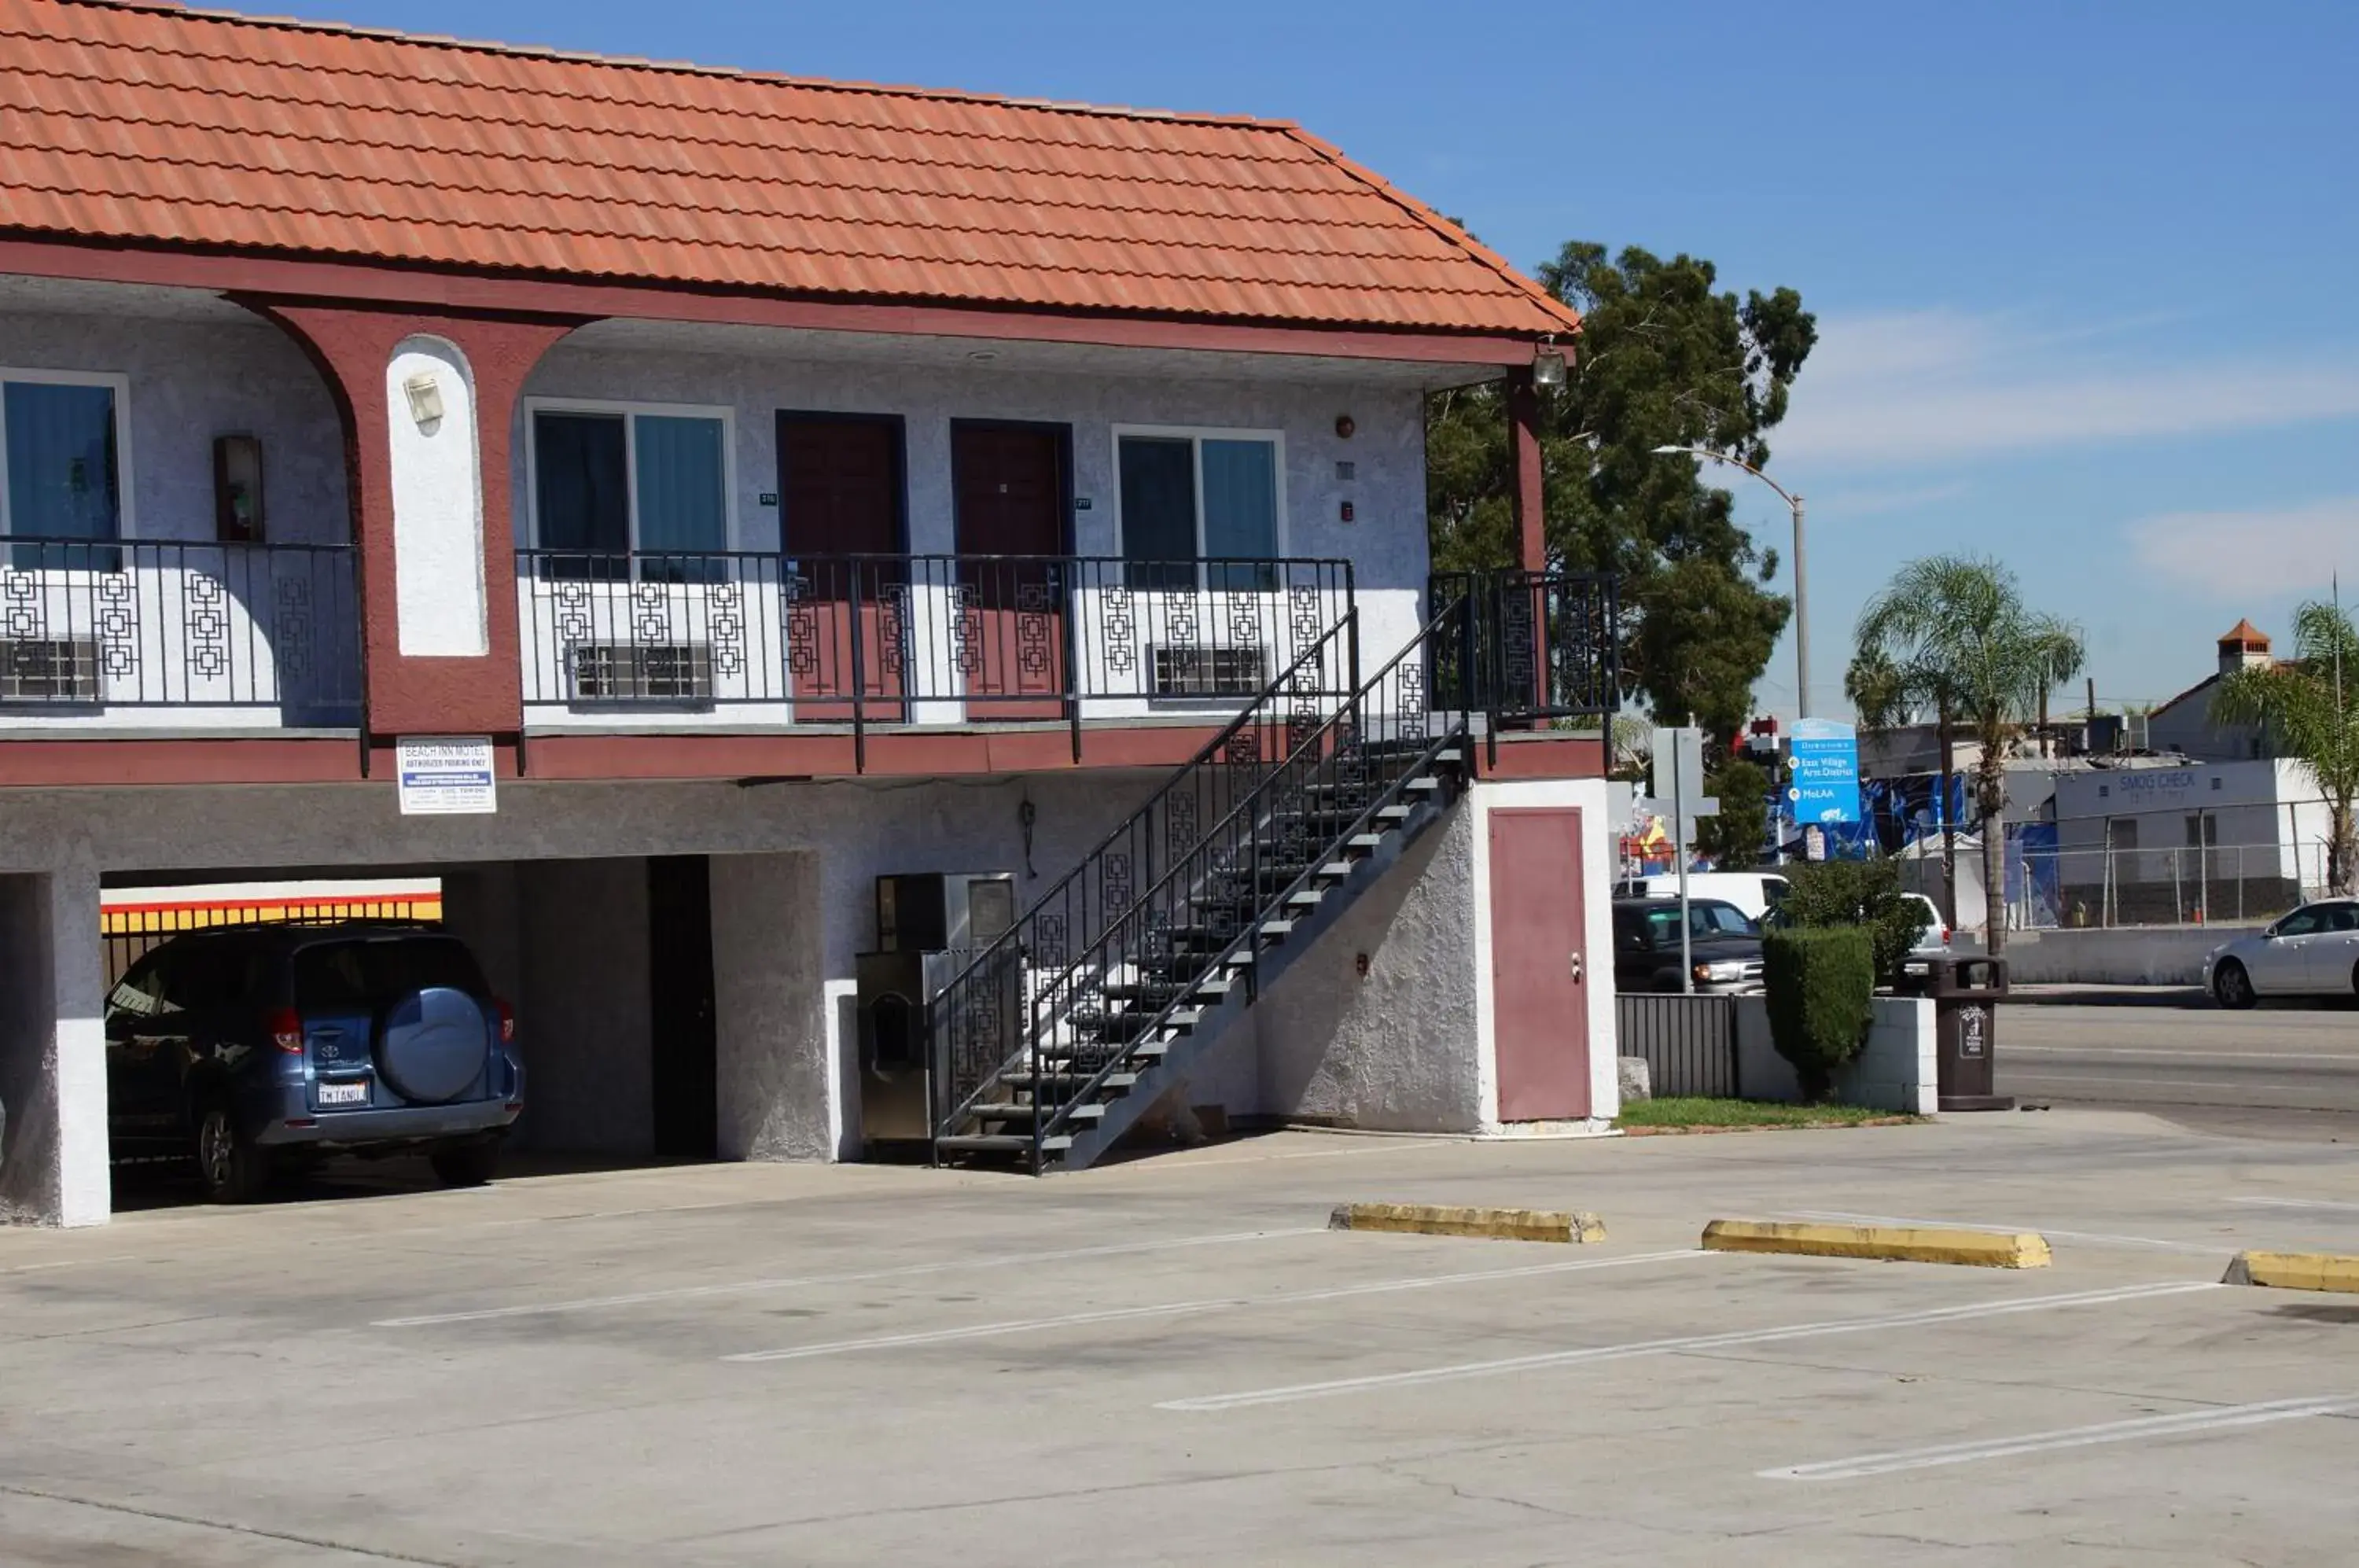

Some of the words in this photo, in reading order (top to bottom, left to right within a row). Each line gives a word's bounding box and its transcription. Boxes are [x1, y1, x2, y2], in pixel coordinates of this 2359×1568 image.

[405, 744, 436, 757] BEACH
[438, 744, 454, 756] INN
[455, 744, 486, 756] MOTEL
[406, 759, 443, 768] AUTHORIZED
[444, 759, 469, 767] PARKING
[471, 758, 486, 767] ONLY
[1801, 758, 1819, 767] East
[1820, 757, 1847, 768] Village
[1803, 767, 1822, 777] Arts
[1822, 767, 1853, 777] District
[2120, 775, 2155, 791] SMOG
[2158, 771, 2195, 788] CHECK
[1802, 790, 1835, 800] MoLAA
